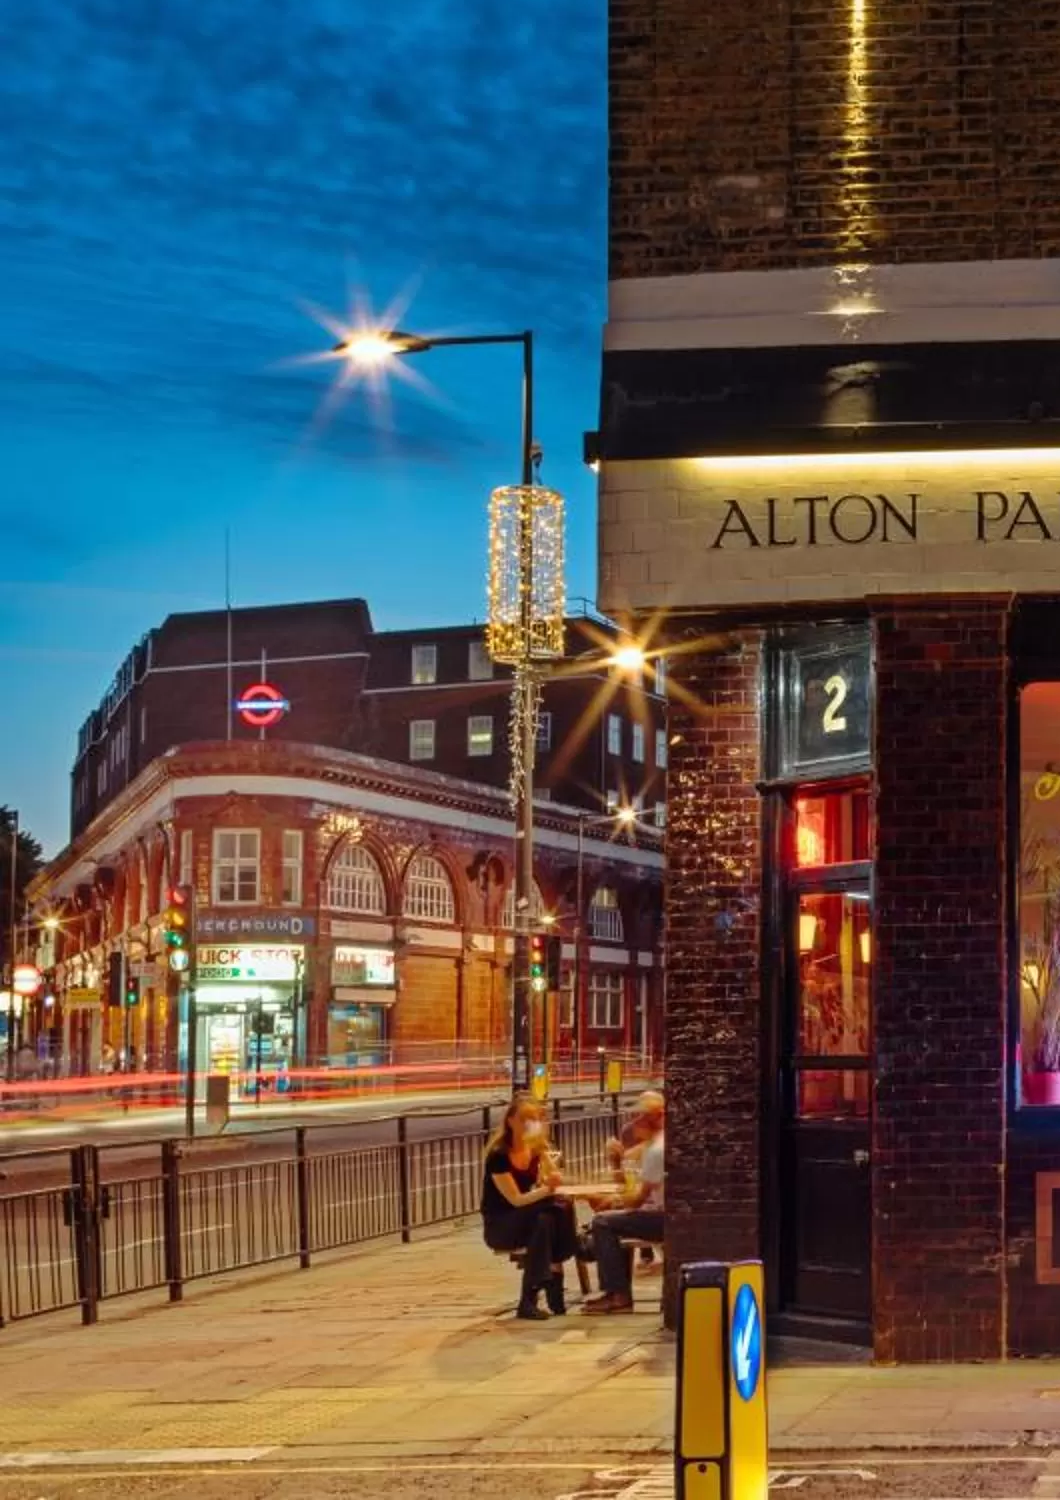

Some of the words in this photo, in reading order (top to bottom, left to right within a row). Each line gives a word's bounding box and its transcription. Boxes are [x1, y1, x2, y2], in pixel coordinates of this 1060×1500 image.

[711, 493, 922, 549] ALTON
[822, 675, 848, 733] 2
[201, 949, 242, 967] UICK
